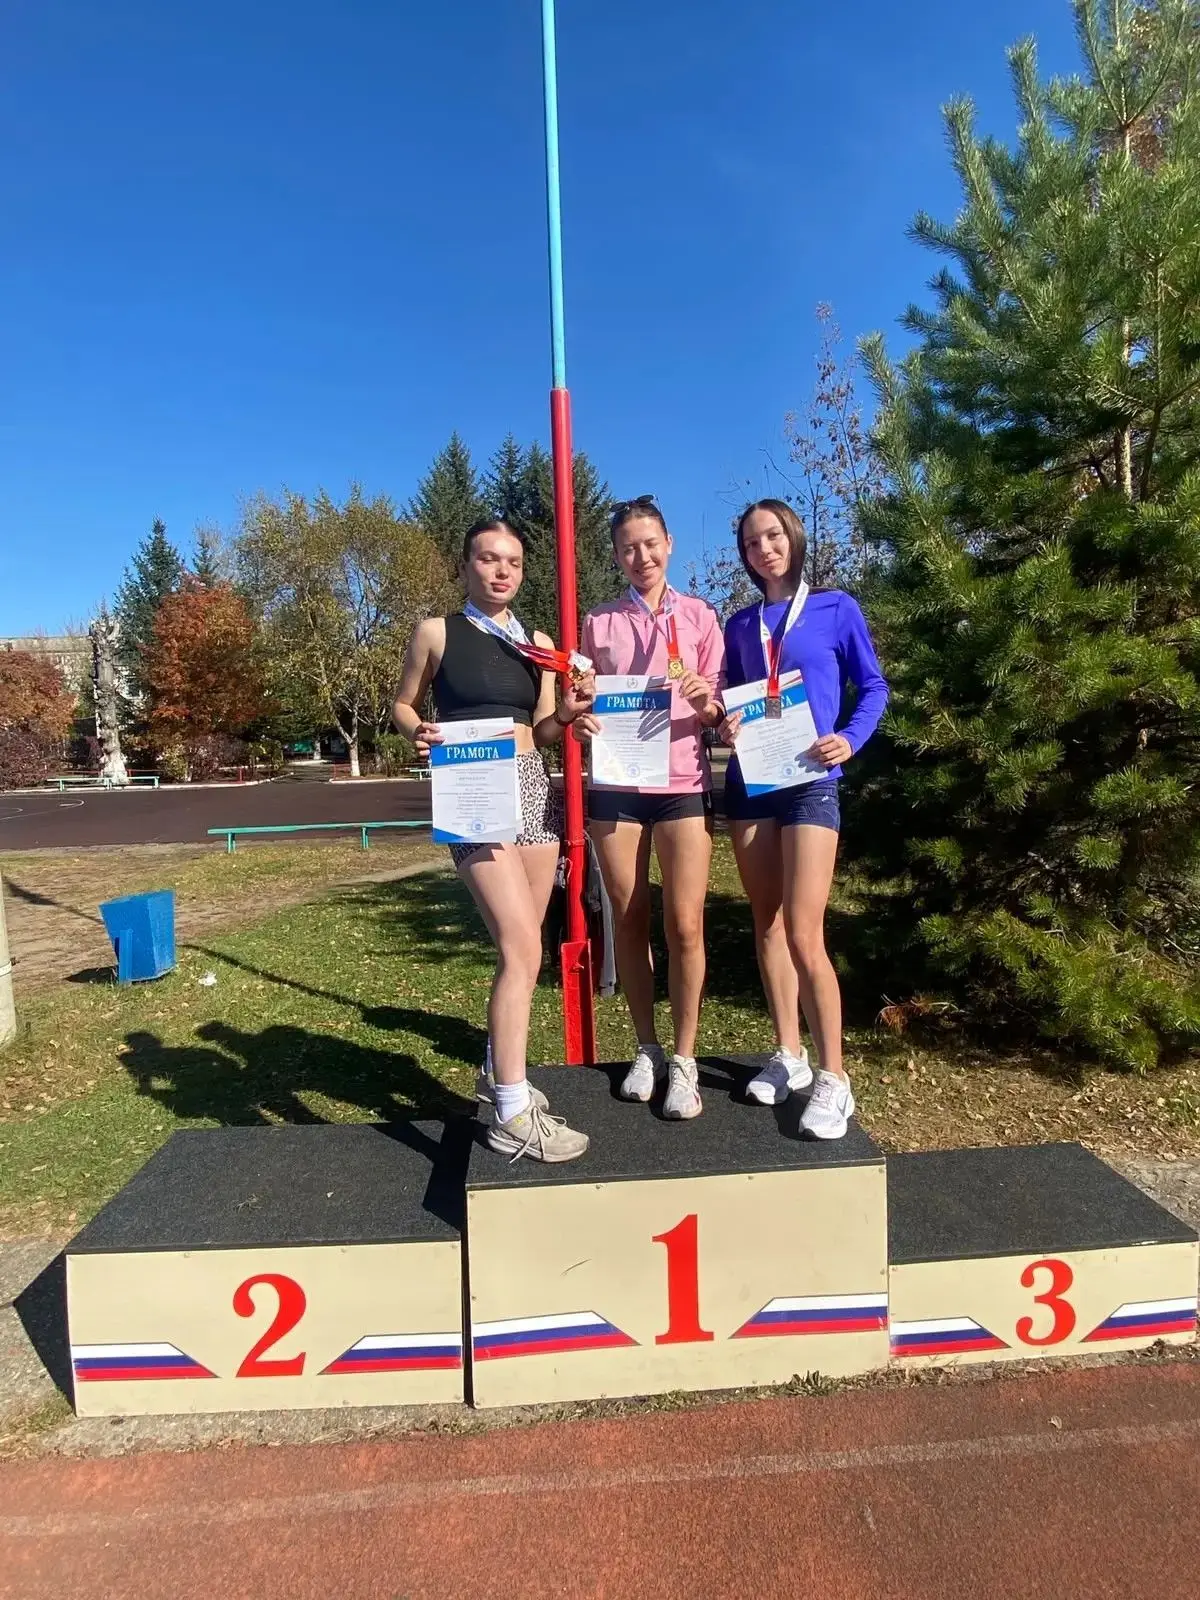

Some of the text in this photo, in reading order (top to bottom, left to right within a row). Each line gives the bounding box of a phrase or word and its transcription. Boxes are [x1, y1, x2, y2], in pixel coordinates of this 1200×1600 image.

[606, 696, 657, 709] ГРАМОТА
[446, 746, 500, 759] ГРАМОТА
[654, 1214, 713, 1345] 1
[1016, 1259, 1076, 1346] 3
[233, 1273, 307, 1377] 2
